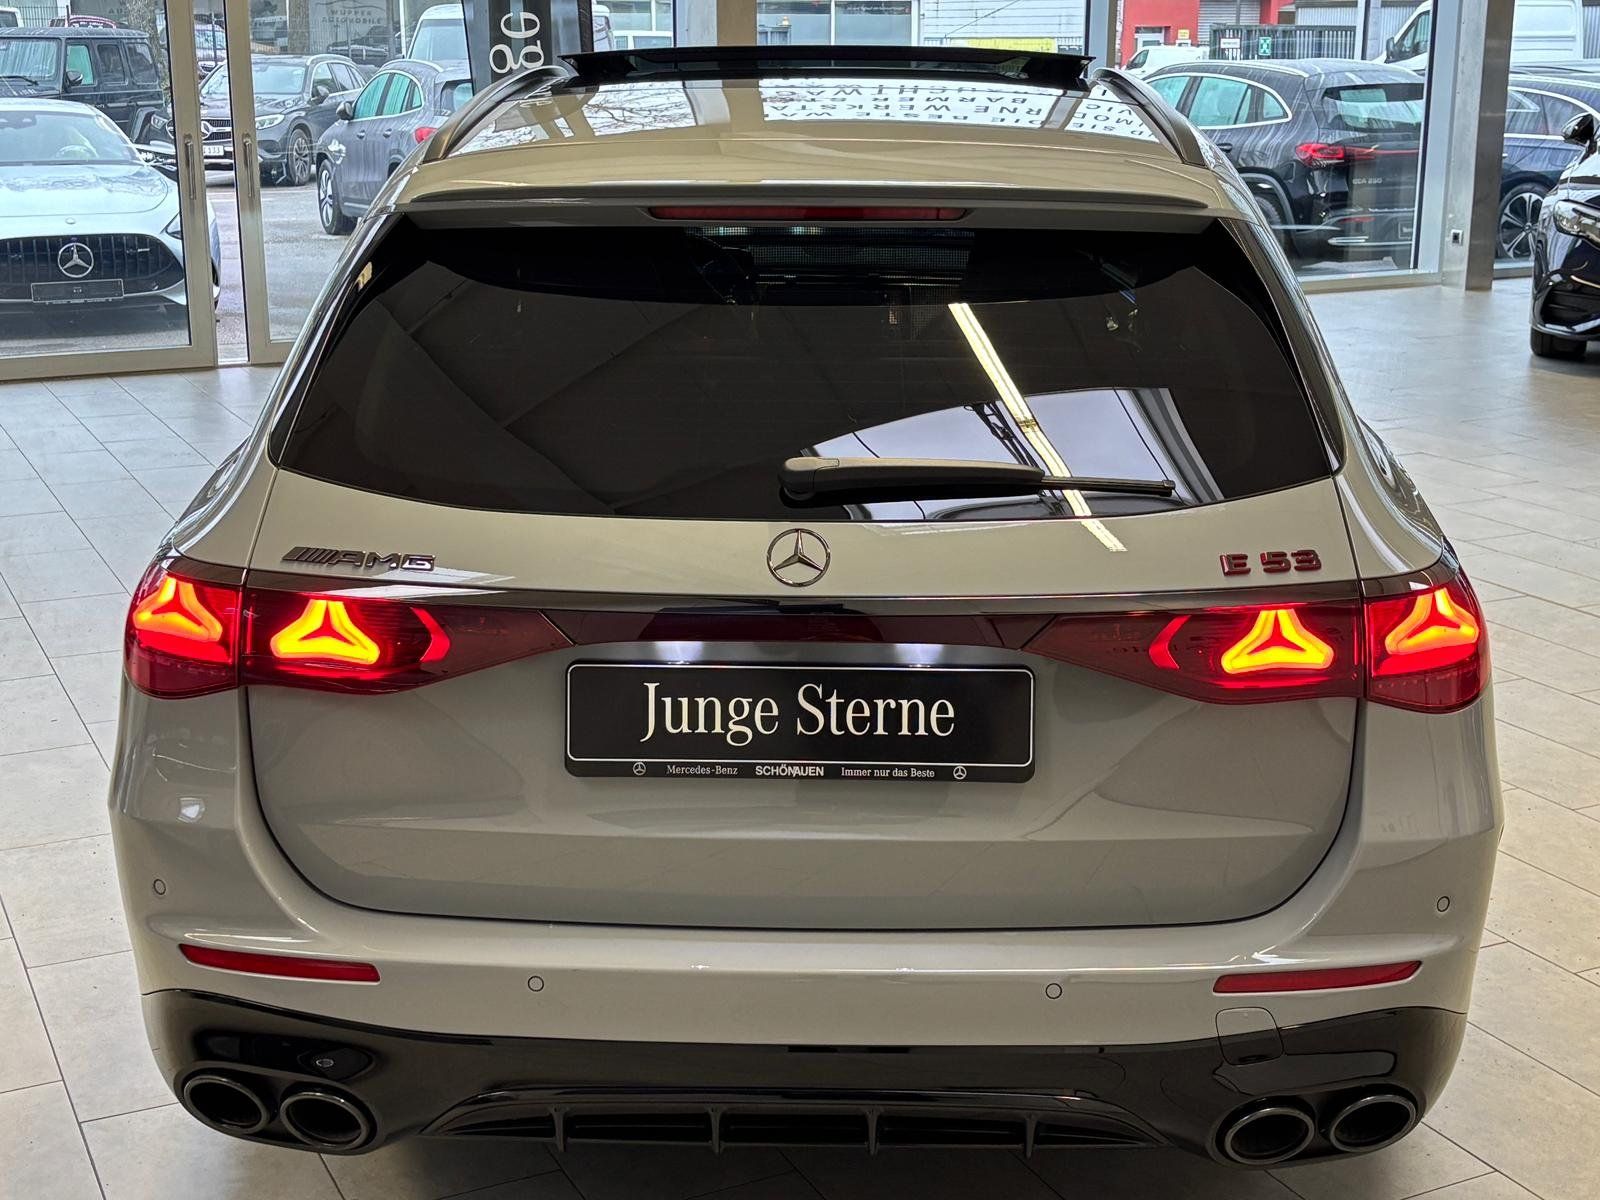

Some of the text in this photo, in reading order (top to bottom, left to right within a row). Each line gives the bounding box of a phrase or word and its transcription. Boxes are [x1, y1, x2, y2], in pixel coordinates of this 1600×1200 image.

[325, 549, 435, 571] AMG
[1219, 549, 1322, 576] E 53
[640, 682, 955, 747] Junge Sterne
[666, 764, 738, 775] Mercedes-Benz
[841, 766, 935, 778] Immer nur das Beste
